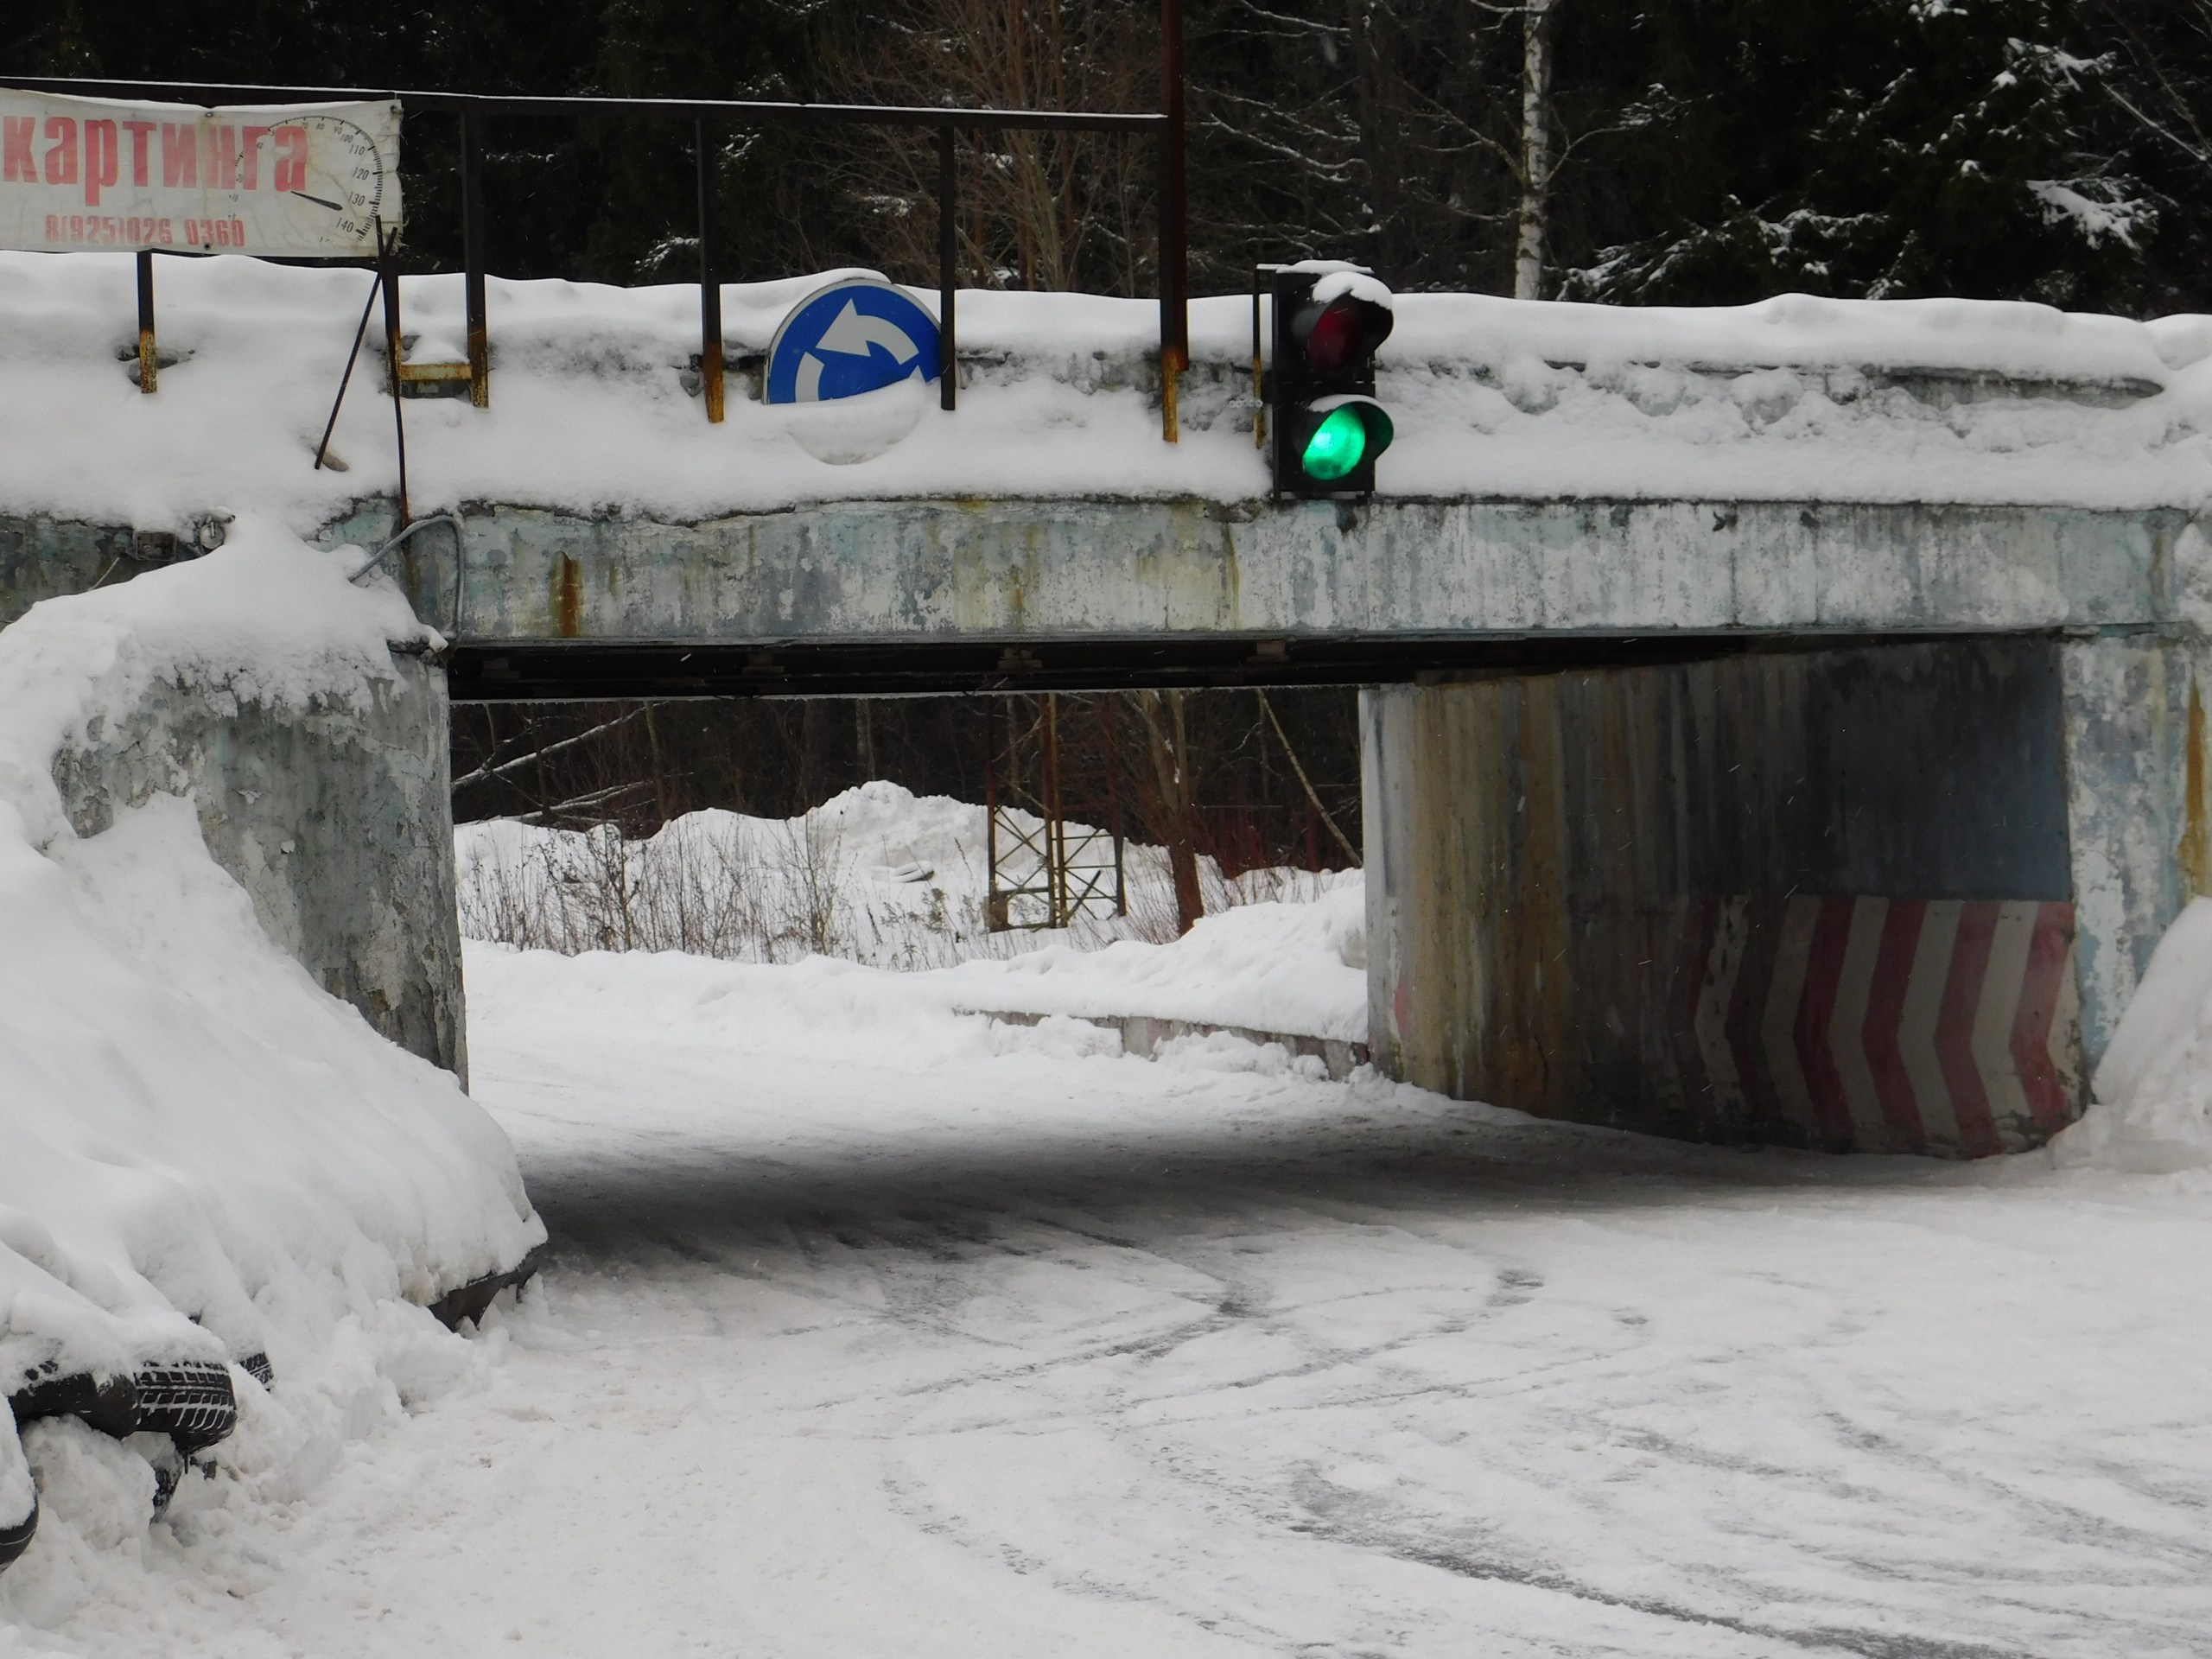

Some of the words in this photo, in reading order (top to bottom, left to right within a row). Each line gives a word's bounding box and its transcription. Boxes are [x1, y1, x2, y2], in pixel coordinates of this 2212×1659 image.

[340, 134, 354, 143] 100
[349, 144, 365, 156] 110
[3, 116, 308, 207] картинга
[353, 167, 370, 181] 120
[348, 192, 365, 207] 130
[336, 217, 354, 233] 140
[184, 219, 245, 247] 0360
